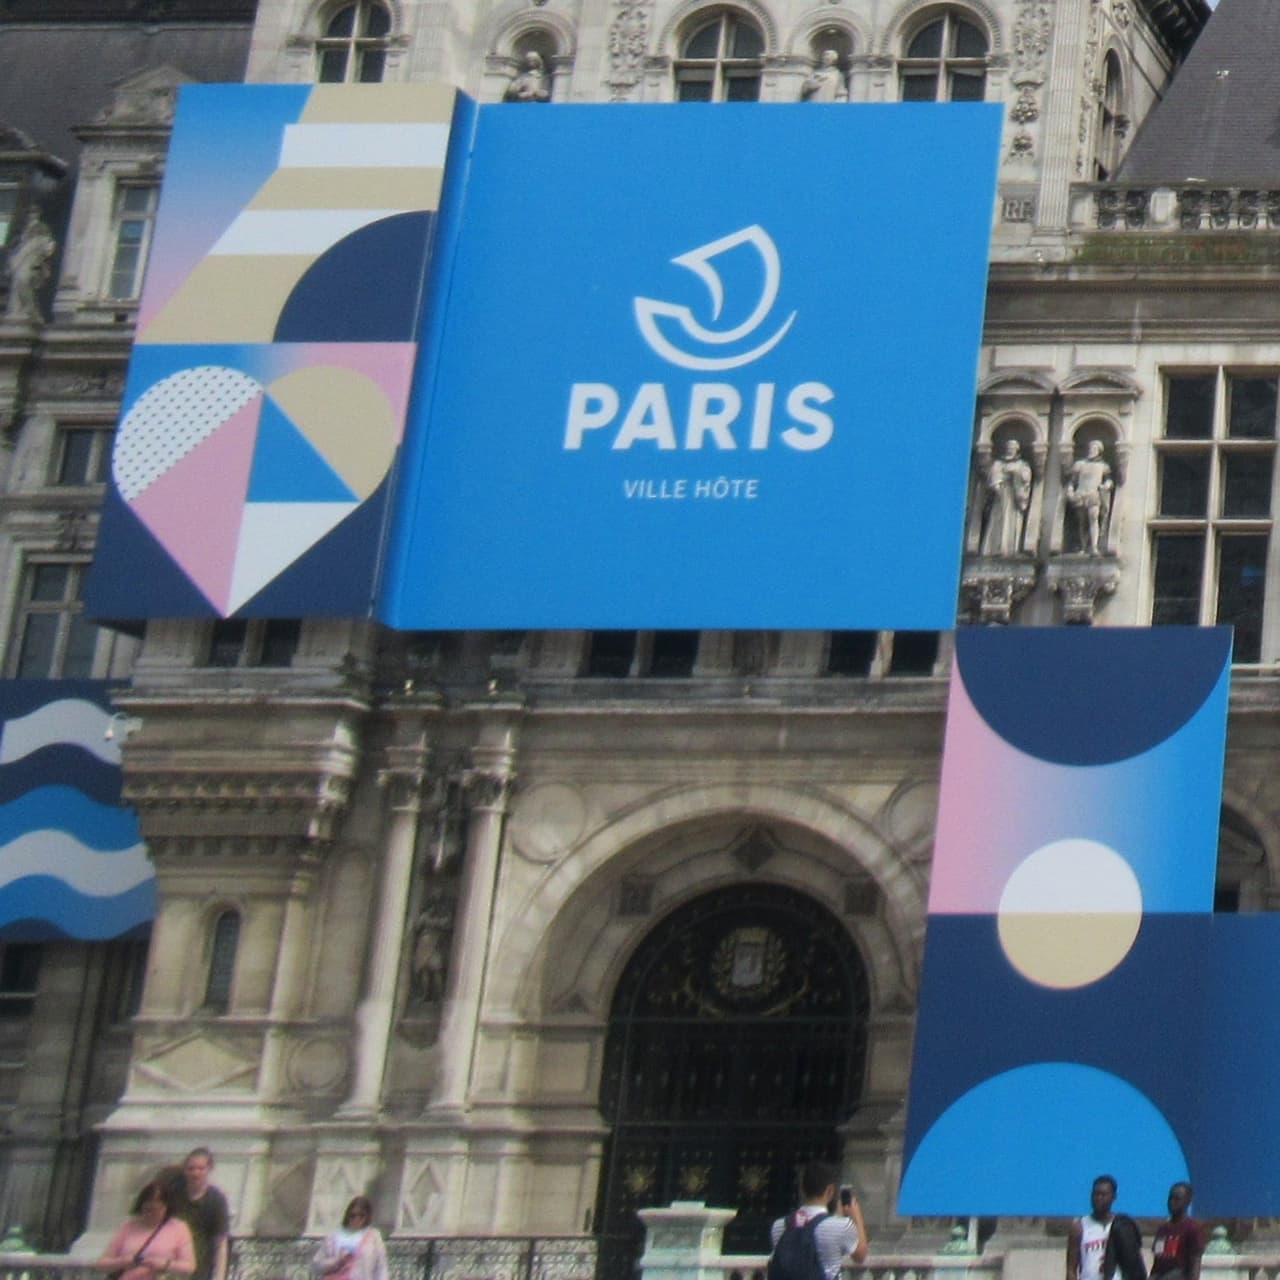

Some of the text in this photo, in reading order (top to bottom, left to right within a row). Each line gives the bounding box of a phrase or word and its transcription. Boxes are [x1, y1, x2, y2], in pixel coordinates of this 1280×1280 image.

[563, 381, 835, 451] PARIS
[623, 476, 759, 499] VILLE HÔTE
